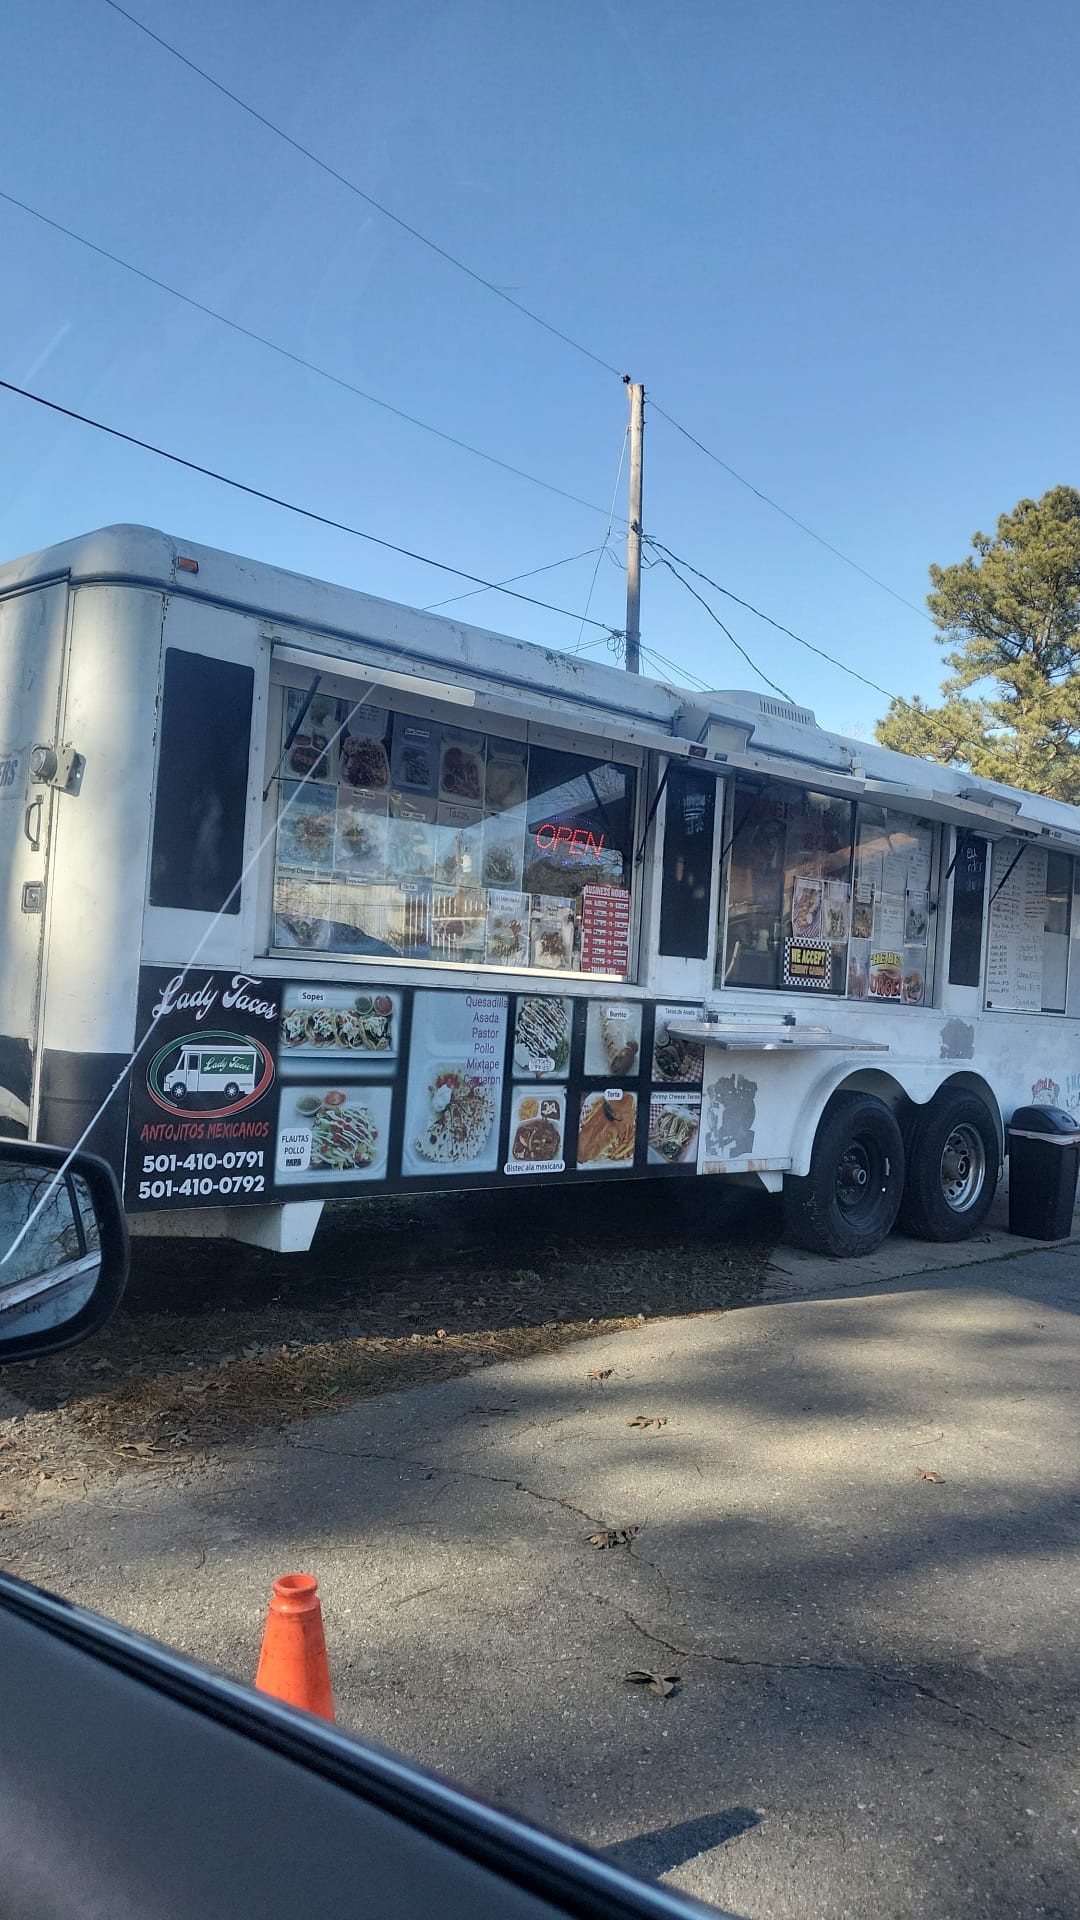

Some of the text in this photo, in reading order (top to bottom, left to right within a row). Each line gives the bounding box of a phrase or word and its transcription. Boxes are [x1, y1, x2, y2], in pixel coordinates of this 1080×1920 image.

[536, 824, 605, 858] OPEN
[584, 885, 629, 899] BUSINESS HOURS
[791, 948, 826, 966] WE ACCEPT
[886, 951, 903, 965] BE
[869, 973, 903, 997] URGE
[152, 975, 279, 1021] Lady Tacos
[302, 991, 325, 1001] Sopes
[472, 1011, 500, 1023] Asada
[472, 1027, 500, 1039] Pastor
[474, 1042, 496, 1054] Pollo
[203, 1055, 252, 1073] Lady Tacos
[607, 1090, 621, 1098] Torta
[140, 1121, 271, 1141] ANTOJITOS MEXICANOS
[281, 1134, 310, 1144] FLAUTAS
[284, 1146, 305, 1155] POLLO
[142, 1151, 265, 1173] 501-410-0791
[506, 1164, 525, 1172] Bistec
[536, 1162, 564, 1170] mexicana
[138, 1175, 265, 1200] 501-410-0792
